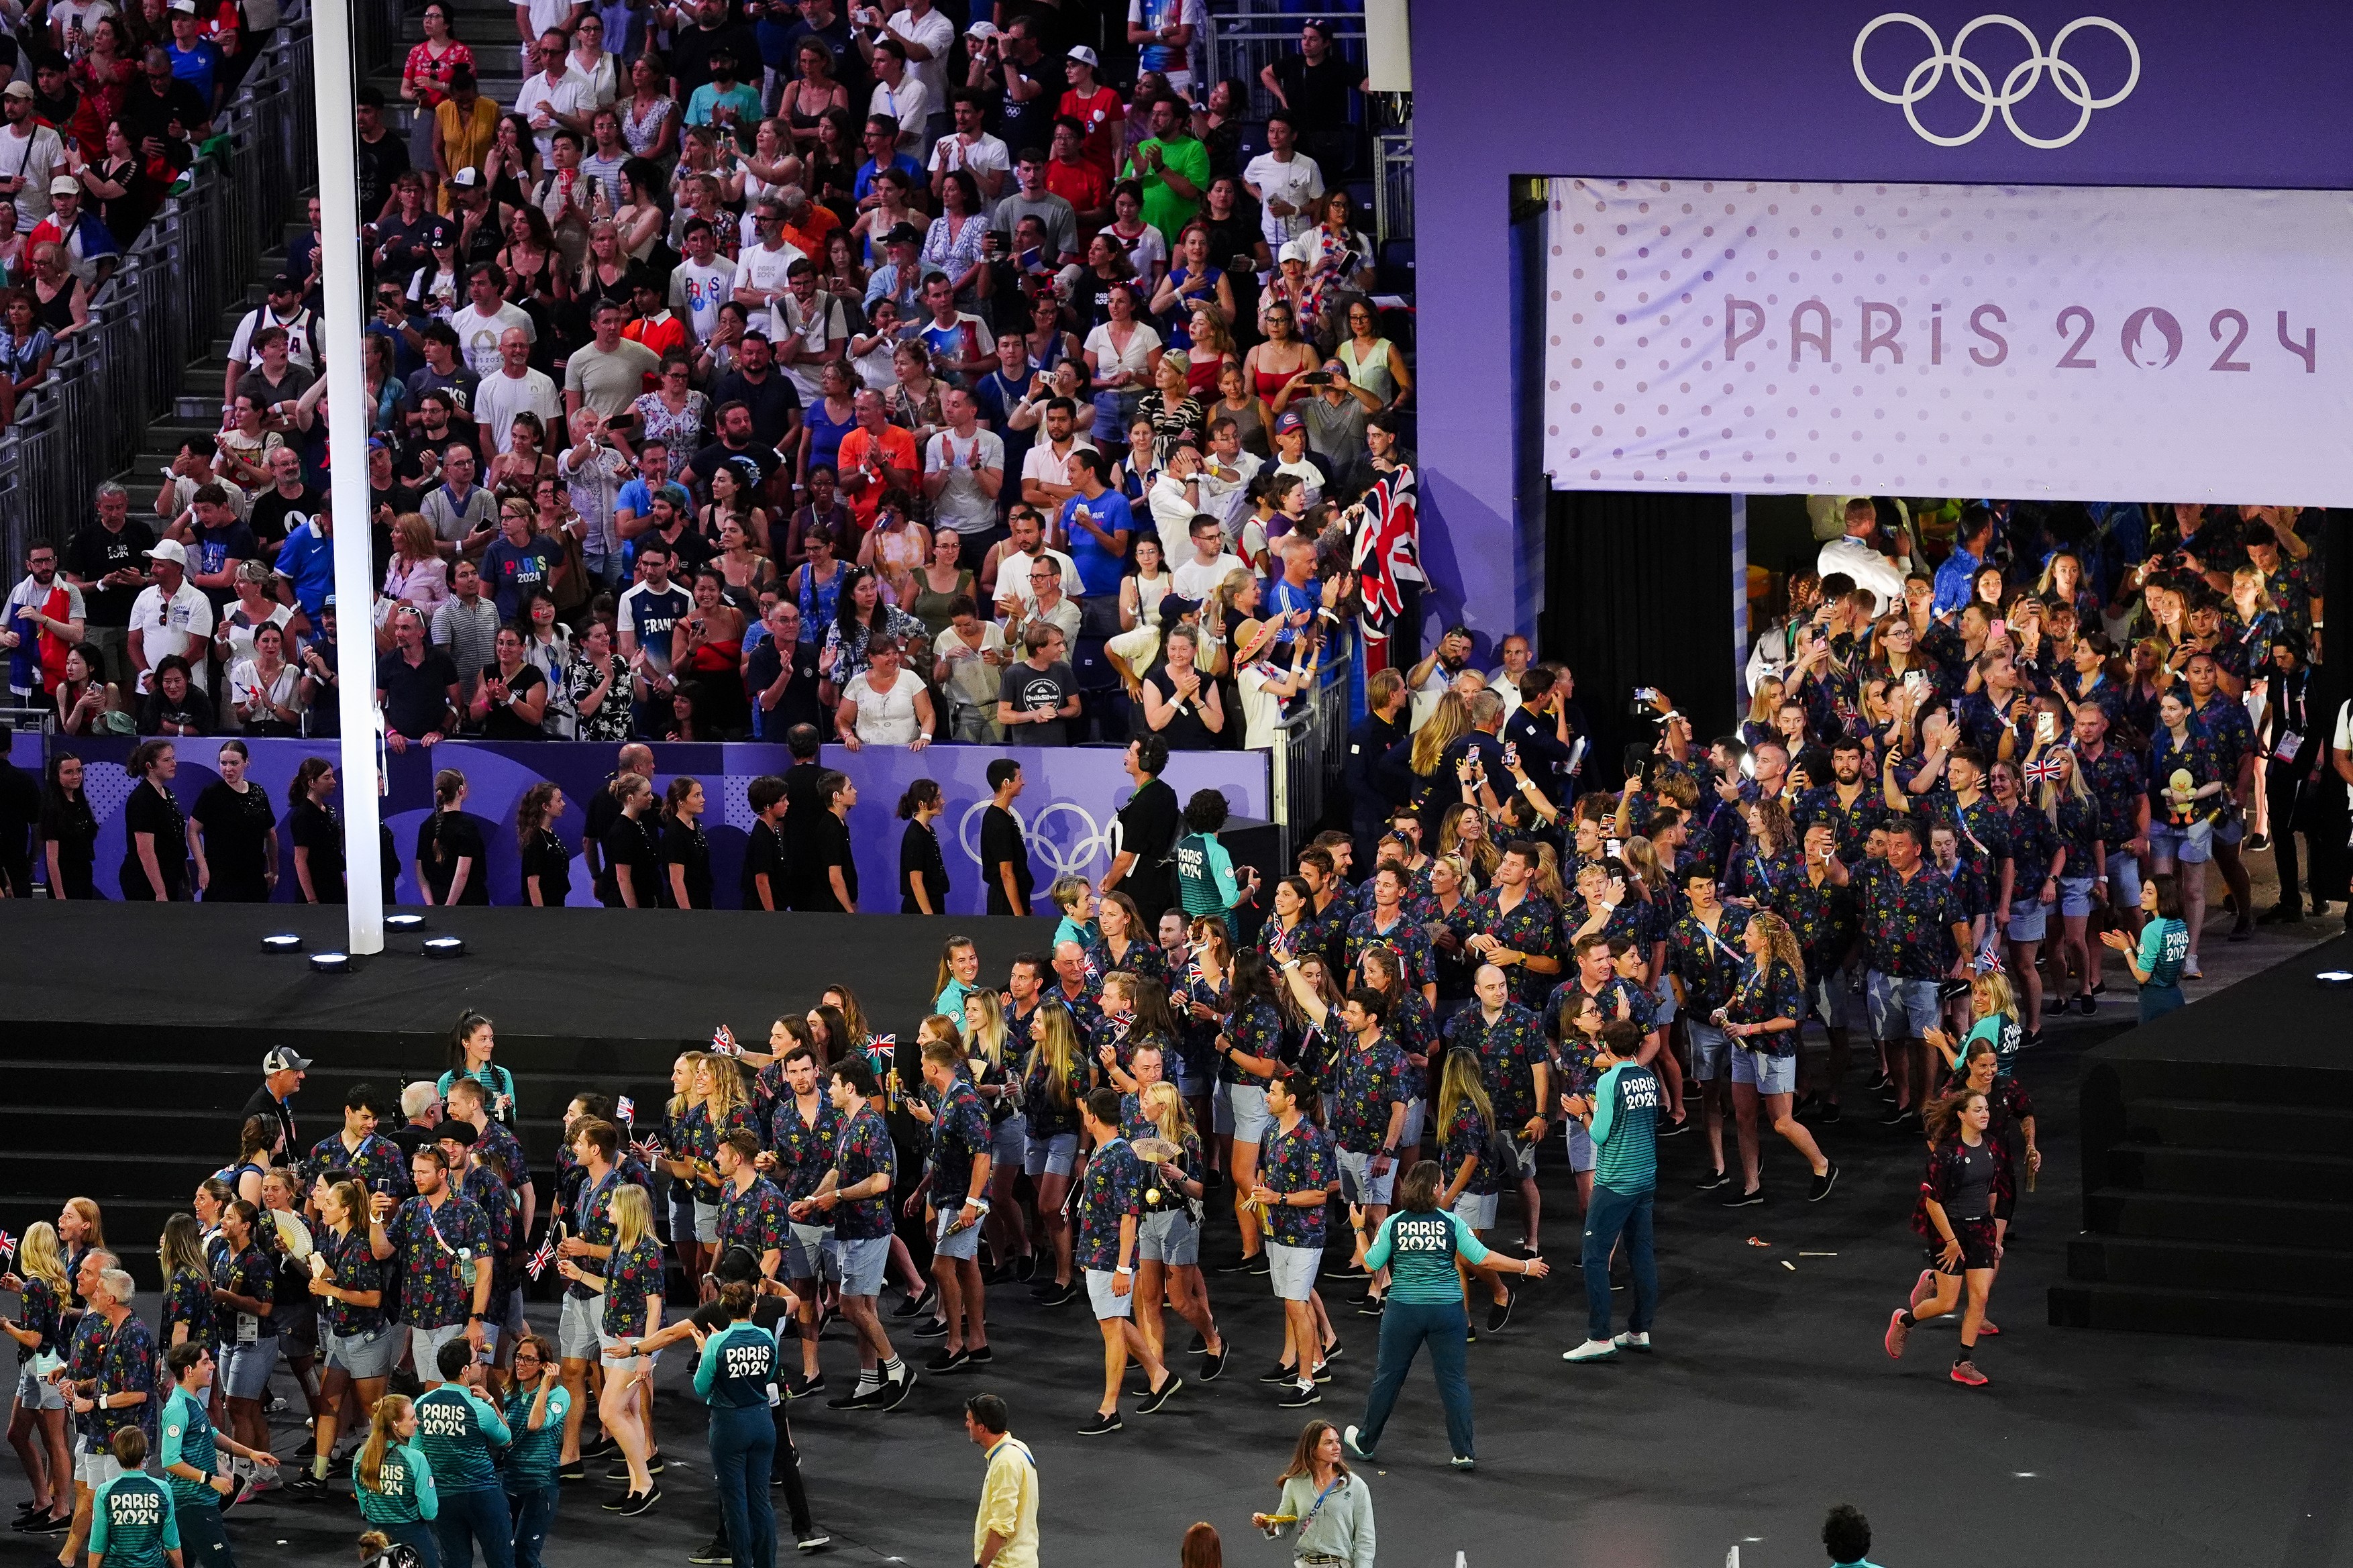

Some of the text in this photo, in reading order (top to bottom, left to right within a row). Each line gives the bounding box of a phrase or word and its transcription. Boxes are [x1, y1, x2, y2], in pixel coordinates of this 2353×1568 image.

[2055, 305, 2316, 374] 2024
[517, 571, 541, 583] 2024
[2166, 945, 2187, 961] 202
[1626, 1091, 1657, 1110] 2024
[1398, 1235, 1447, 1251] 2024
[728, 1361, 769, 1378] 2024
[423, 1419, 466, 1436] 2024
[113, 1509, 159, 1525] 2024
